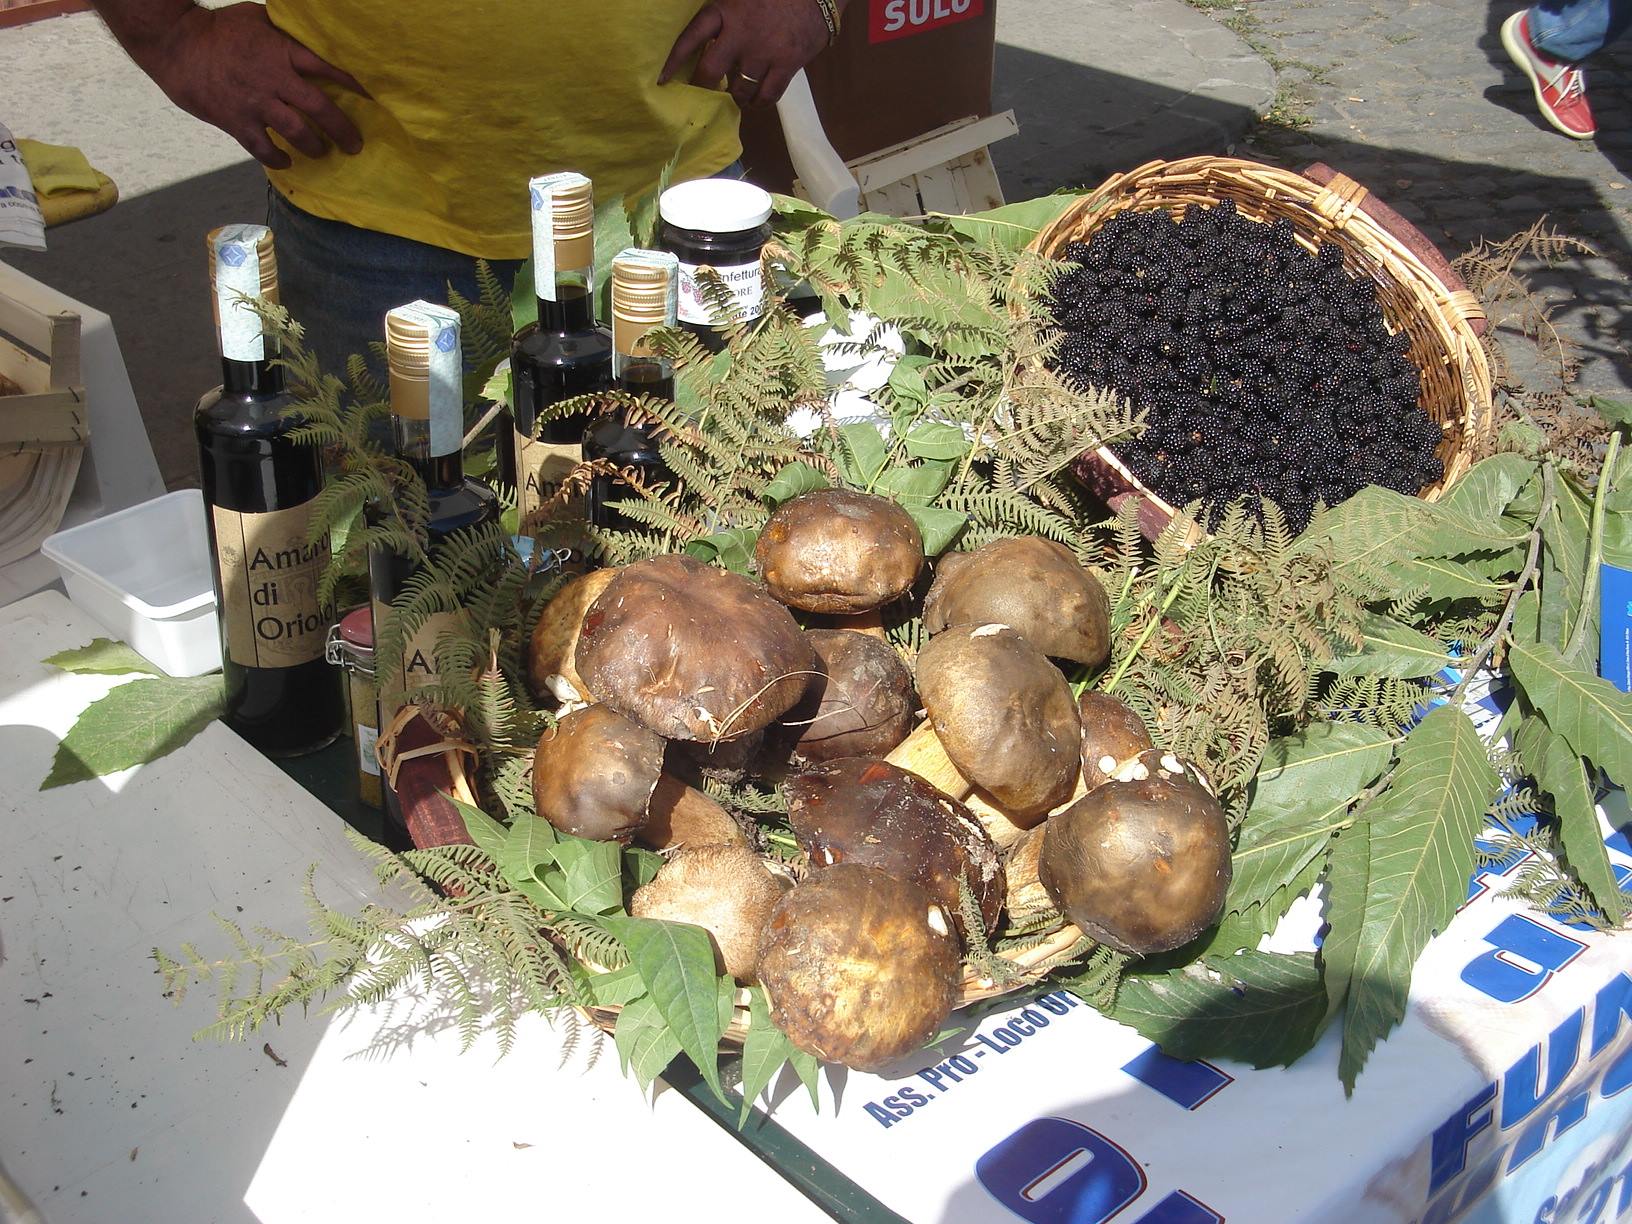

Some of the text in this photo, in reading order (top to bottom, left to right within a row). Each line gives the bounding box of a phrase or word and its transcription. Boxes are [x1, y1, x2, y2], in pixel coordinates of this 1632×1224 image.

[250, 532, 329, 571] Amaro
[253, 583, 278, 606] di
[257, 603, 333, 640] Oriolo
[863, 1086, 935, 1128] Ass.
[917, 1054, 979, 1092] Pro
[1034, 990, 1080, 1016] Or
